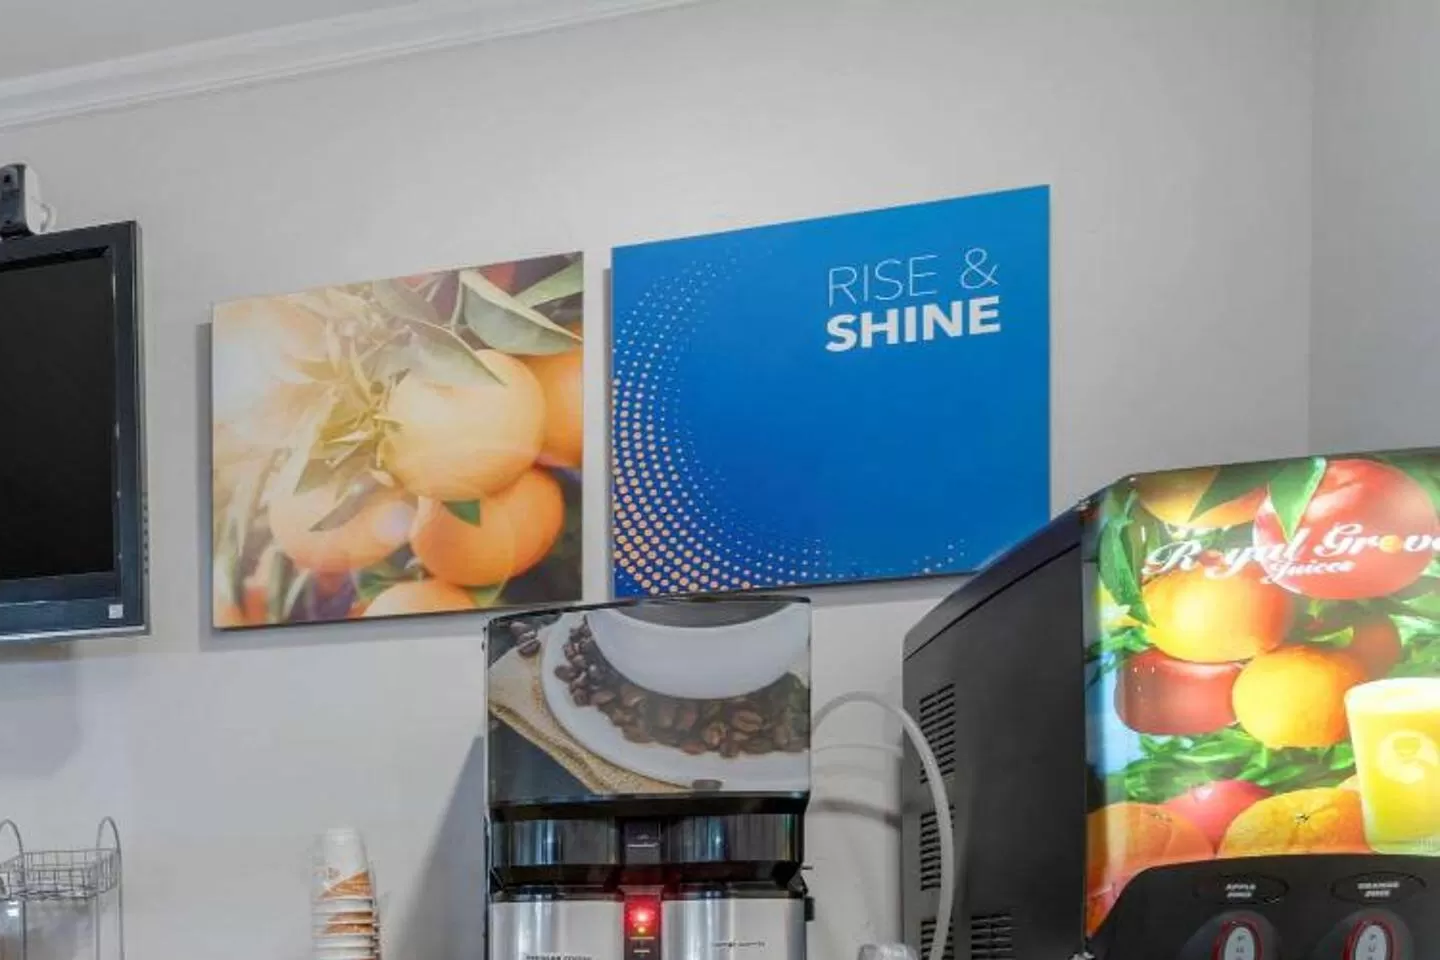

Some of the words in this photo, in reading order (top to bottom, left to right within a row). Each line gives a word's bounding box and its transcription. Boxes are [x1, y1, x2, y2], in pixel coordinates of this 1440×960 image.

[828, 254, 938, 308] RISE
[960, 247, 1001, 290] &
[825, 295, 1001, 352] SHINE
